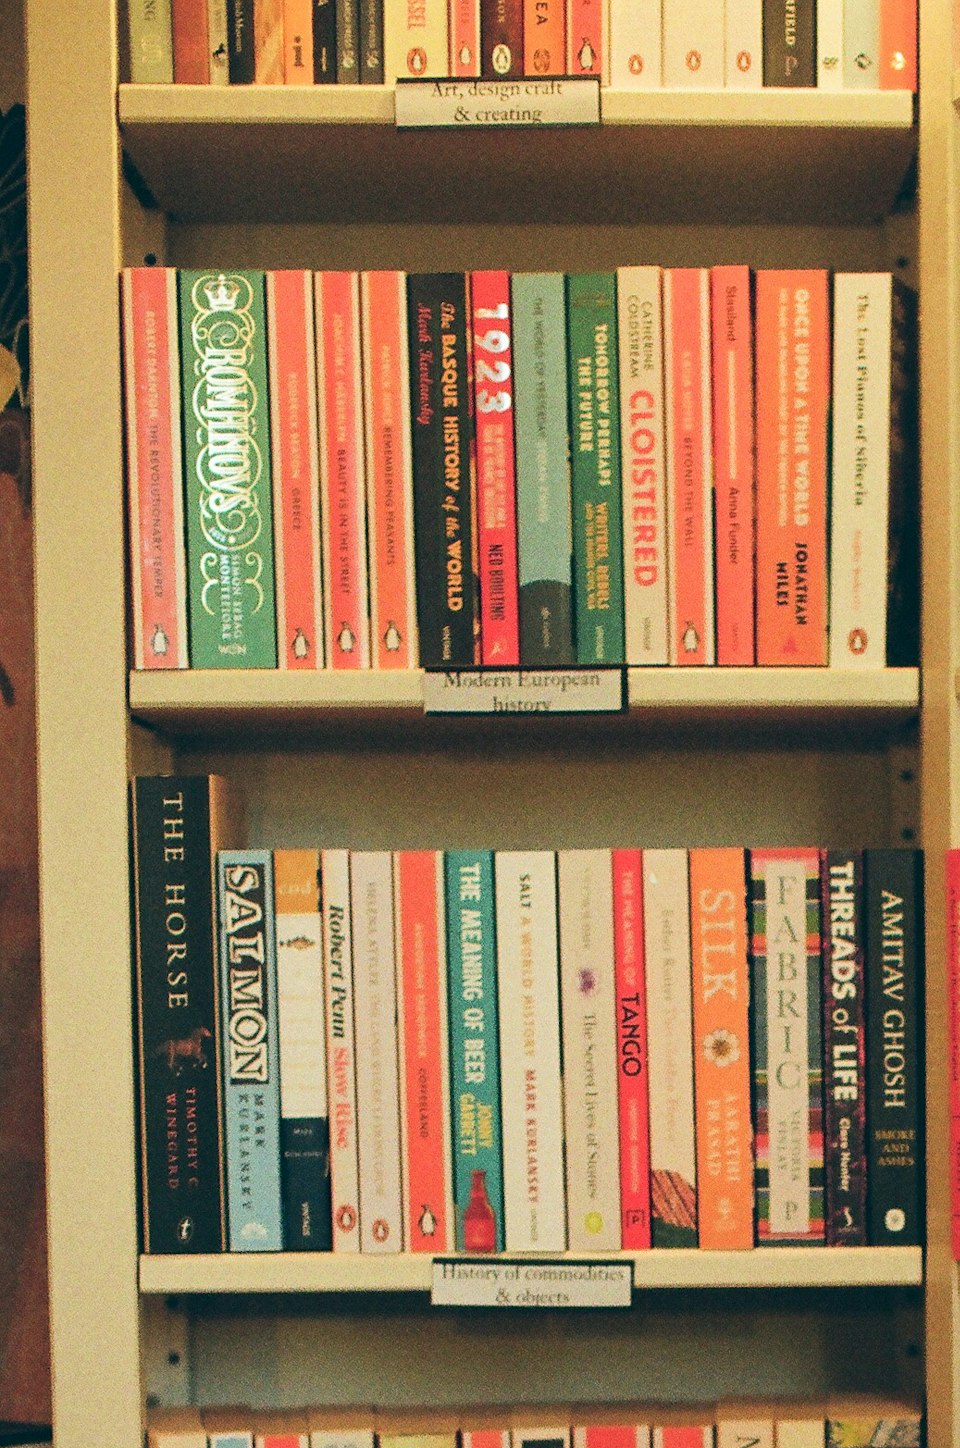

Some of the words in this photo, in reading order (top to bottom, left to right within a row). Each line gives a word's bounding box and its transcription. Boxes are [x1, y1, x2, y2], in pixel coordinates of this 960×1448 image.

[431, 82, 464, 99] Art,
[468, 82, 521, 100] design
[454, 105, 470, 121] &
[475, 105, 543, 122] creating
[417, 302, 431, 343] Mark
[441, 302, 455, 329] The
[725, 286, 738, 341] Stasiland
[794, 288, 809, 338] ONCE
[855, 294, 868, 322] The
[475, 302, 511, 414] 1923
[627, 295, 641, 379] COLDSTREAM
[641, 301, 654, 372] CATHERINE
[855, 327, 868, 363] Lost
[416, 350, 433, 425] Kurlansky
[441, 335, 457, 407] BASQUE
[579, 357, 591, 386] THE
[594, 323, 610, 414] TOMORROW
[794, 344, 810, 394] UPON
[855, 366, 868, 420] Pianos
[579, 392, 593, 451] FUTURE
[794, 398, 809, 409] A
[149, 425, 159, 446] THE
[200, 347, 251, 514] ROMANOVS
[443, 416, 459, 491] HISTORY
[596, 420, 611, 486] PERHAPS
[795, 415, 809, 453] TIME
[855, 425, 868, 442] of
[337, 449, 348, 494] BEAUTY
[683, 437, 694, 487] BEYOND
[854, 447, 868, 506] Siberia
[150, 450, 162, 553] REVOLUTIONARY
[338, 499, 348, 509] IS
[443, 496, 459, 511] of
[629, 390, 658, 587] CLOISTERED
[684, 492, 694, 514] THE
[728, 487, 739, 519] Anna
[794, 460, 810, 526] WORLD
[338, 514, 348, 528] IN
[339, 532, 349, 552] THE
[445, 518, 458, 537] the
[684, 518, 695, 547] WALL
[729, 523, 740, 565] Funder
[152, 556, 163, 597] TEMPER
[340, 557, 350, 594] STREET
[447, 540, 461, 611] WORLD
[488, 544, 504, 566] NED
[220, 554, 231, 639] MONTEFIORE
[489, 571, 505, 621] BOULTING
[776, 562, 789, 606] MILES
[794, 542, 808, 625] JONATHAN
[444, 671, 512, 687] Modern
[519, 671, 600, 691] European
[493, 696, 551, 711] history
[163, 792, 184, 862] THE
[459, 863, 482, 901] THE
[519, 874, 532, 909] SALT
[165, 885, 189, 1009] HORSE
[329, 904, 347, 980] Robert
[521, 916, 532, 928] A
[699, 888, 738, 1004] SILK
[829, 861, 856, 1000] THREADS
[881, 890, 905, 1001] AMITAV
[224, 865, 268, 1082] SALMON
[460, 909, 484, 1000] MEANING
[521, 931, 533, 989] WORLD
[774, 876, 801, 1090] FABRIC
[331, 985, 347, 1039] Penn
[463, 1008, 485, 1031] OF
[522, 994, 536, 1057] HISTORY
[583, 1013, 597, 1040] The
[621, 993, 641, 1077] TANGO
[833, 1008, 859, 1033] of
[334, 1046, 350, 1096] Slow
[464, 1038, 486, 1084] BEER
[583, 1043, 598, 1087] Secret
[833, 1044, 859, 1101] LIFE
[883, 1009, 905, 1108] GHOSH
[417, 1068, 429, 1138] COFFEELAND
[525, 1070, 537, 1111] MARK
[585, 1092, 599, 1128] Lives
[166, 1093, 179, 1189] WINEGARD
[185, 1087, 198, 1168] TIMOTHY
[253, 1093, 266, 1148] MARK
[335, 1102, 352, 1148] Rise
[459, 1093, 477, 1156] GARRETT
[478, 1103, 492, 1147] JONNY
[586, 1133, 599, 1148] of
[706, 1099, 722, 1177] PRASAD
[725, 1093, 740, 1182] AARATHI
[838, 1118, 852, 1148] Clare
[238, 1093, 252, 1212] KURLANSKY
[526, 1118, 539, 1203] KURLANSKY
[586, 1151, 601, 1199] Stones
[838, 1152, 851, 1192] Hunter
[443, 1264, 499, 1282] History
[525, 1266, 624, 1281] commodities
[496, 1289, 509, 1302] &
[516, 1289, 570, 1306] objects
